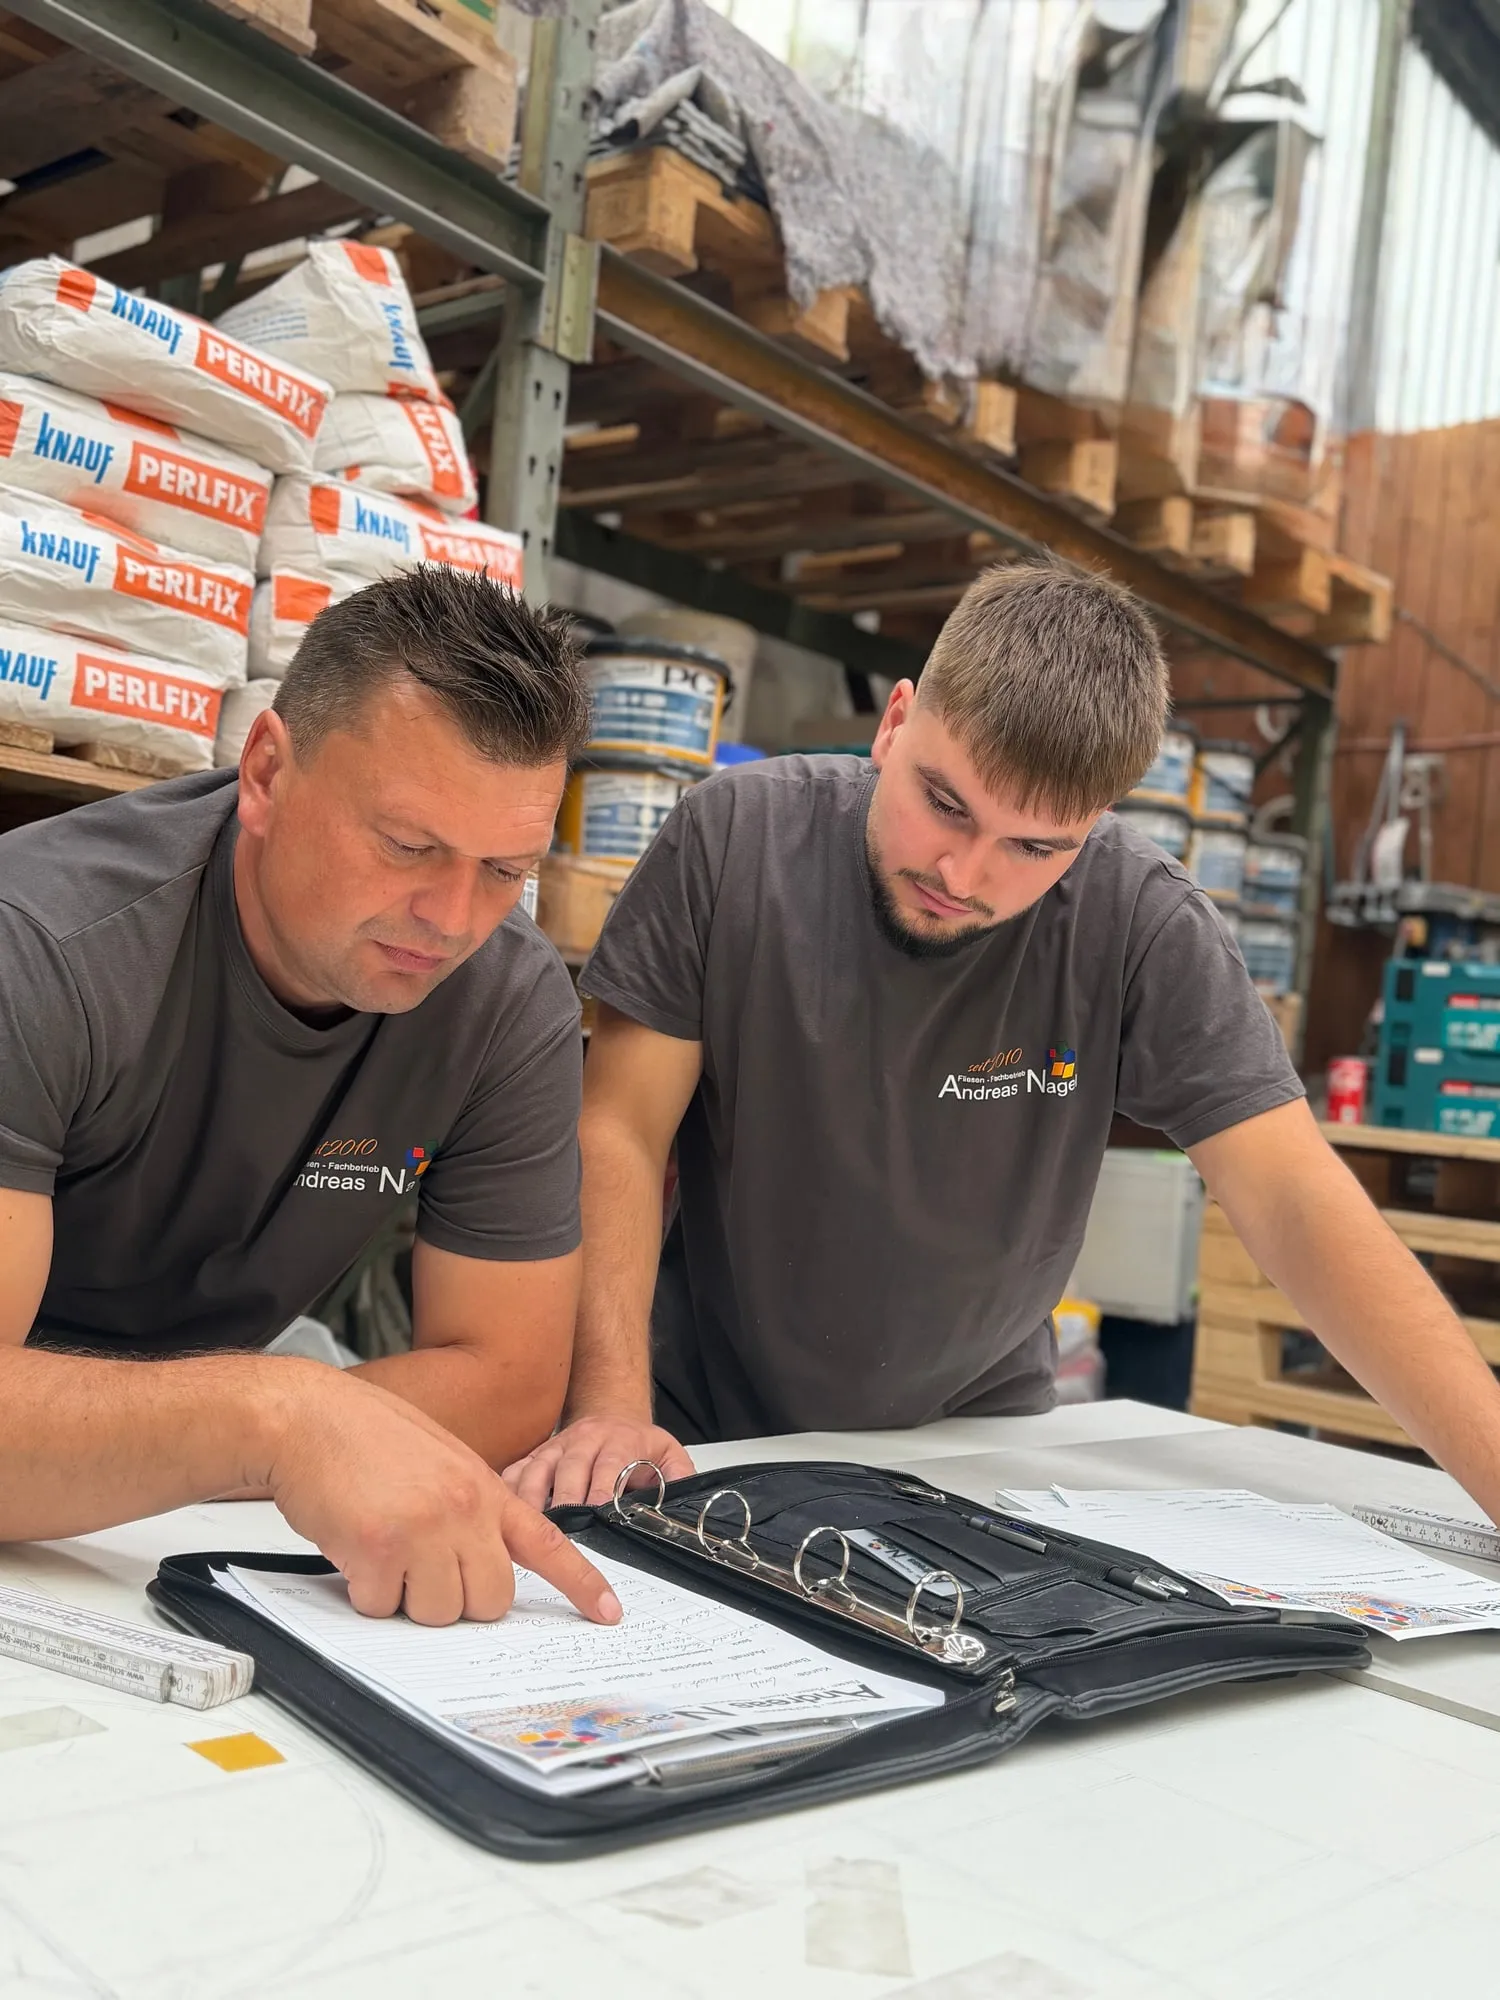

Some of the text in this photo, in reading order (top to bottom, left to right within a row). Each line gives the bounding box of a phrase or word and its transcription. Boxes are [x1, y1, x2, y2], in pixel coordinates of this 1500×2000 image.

[112, 286, 184, 355] KNAUF
[205, 340, 315, 427] PERLFIX
[381, 302, 415, 371] KNAUF
[35, 412, 263, 524] KNAUF PERLFIX
[355, 499, 520, 577] KNAUF PERLFIX
[20, 521, 245, 621] KNAUF PERLFIX
[83, 666, 212, 726] PERLFIX
[938, 1069, 1078, 1101] Andreas Nagel
[957, 1074, 985, 1084] Fliesen
[990, 1070, 1026, 1083] Fachbetrieb
[328, 1161, 380, 1174] Fachbetrieb
[1388, 1504, 1497, 1533] au-Profis
[596, 1705, 738, 1733] Nagel
[727, 1684, 886, 1709] Andreas
